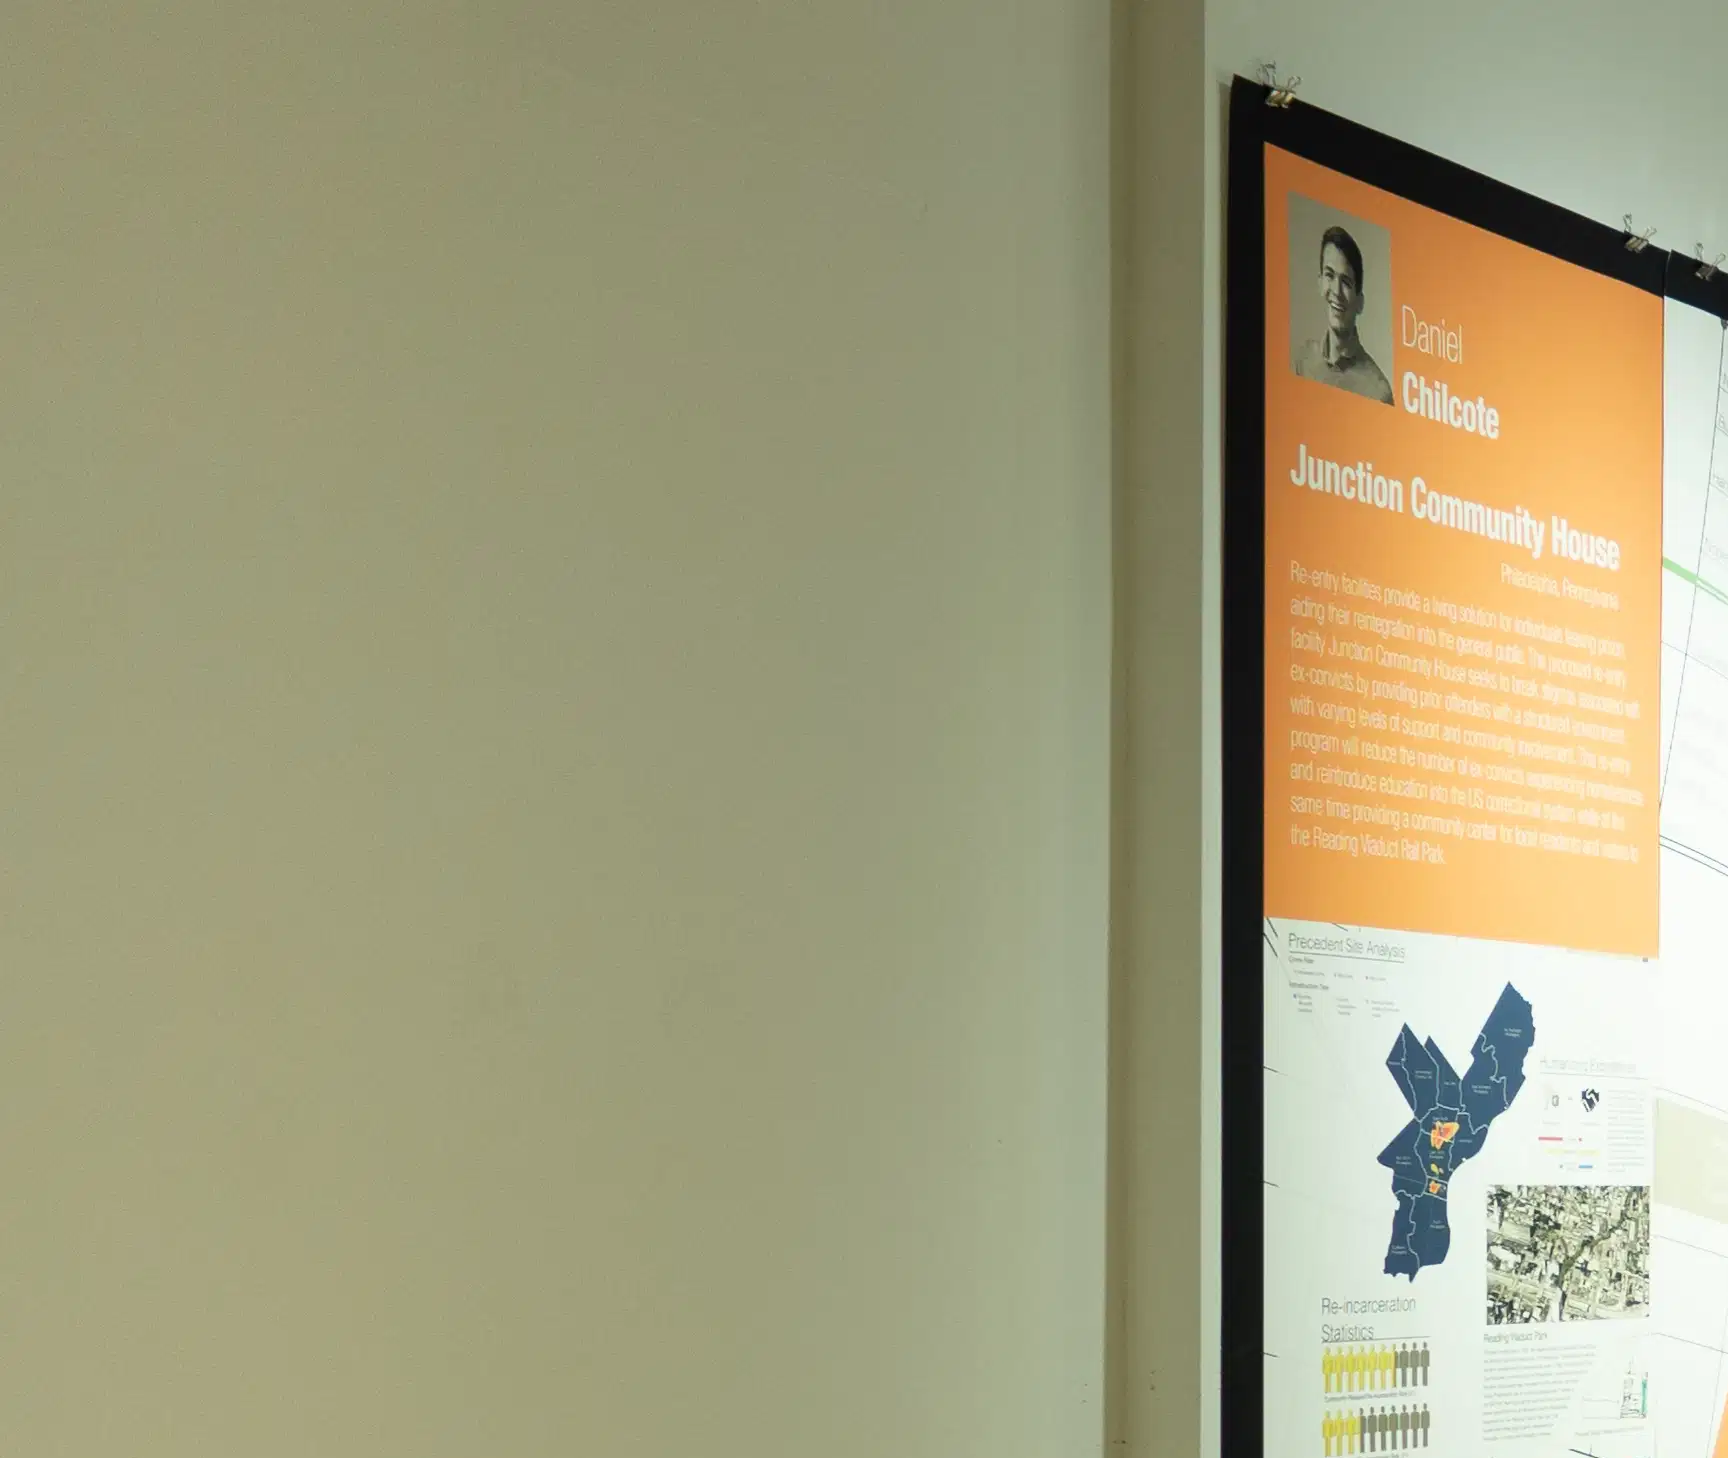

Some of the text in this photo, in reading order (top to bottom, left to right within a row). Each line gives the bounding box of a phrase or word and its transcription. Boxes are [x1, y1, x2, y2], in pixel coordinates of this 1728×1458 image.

[1402, 305, 1463, 365] Daniel
[1403, 370, 1500, 440] Chilcote
[1289, 444, 1622, 571] Junction Community House
[1291, 560, 1339, 595] Re-entry
[1342, 573, 1381, 602] facilities
[1383, 587, 1420, 611] provide
[1423, 597, 1429, 613] a
[1432, 596, 1457, 623] living
[1459, 601, 1497, 628] solution
[1499, 611, 1512, 632] for
[1291, 595, 1325, 625] aiding
[1328, 602, 1349, 625] their
[1353, 611, 1415, 639] reintegration
[1416, 623, 1437, 646] into
[1438, 629, 1453, 650] the
[1456, 635, 1493, 659] general
[1290, 626, 1326, 657] facility
[1328, 636, 1373, 663] Junction
[1375, 644, 1431, 680] Community
[1434, 657, 1466, 684] House
[1468, 666, 1497, 690] seeks
[1499, 672, 1510, 692] to
[1291, 663, 1354, 692] ex-convicts
[1356, 672, 1369, 698] by
[1372, 679, 1418, 708] providing
[1420, 688, 1441, 708] prior
[1445, 691, 1493, 721] offenders
[1290, 694, 1314, 716] with
[1317, 701, 1356, 728] varying
[1358, 706, 1387, 730] levels
[1390, 712, 1401, 732] of
[1402, 718, 1440, 740] support
[1443, 723, 1460, 744] and
[1291, 730, 1339, 754] program
[1342, 736, 1358, 756] will
[1361, 740, 1397, 764] reduce
[1399, 748, 1415, 767] the
[1418, 751, 1455, 772] number
[1458, 757, 1467, 775] of
[1291, 761, 1313, 780] and
[1316, 764, 1377, 792] reintroduce
[1379, 776, 1428, 799] education
[1429, 780, 1449, 804] into
[1450, 787, 1466, 805] the
[1469, 788, 1484, 809] US
[1290, 796, 1323, 816] same
[1326, 797, 1350, 819] time
[1352, 804, 1400, 831] providing
[1403, 812, 1410, 828] a
[1412, 813, 1464, 840] community
[1291, 824, 1310, 847] the
[1313, 826, 1358, 857] Reading
[1360, 832, 1399, 858] Viaduct
[1400, 838, 1420, 861] Rail
[1288, 932, 1406, 960] Precedent Site Analysis
[1321, 1296, 1416, 1317] Re-incarceration
[1321, 1324, 1375, 1343] Statistics
